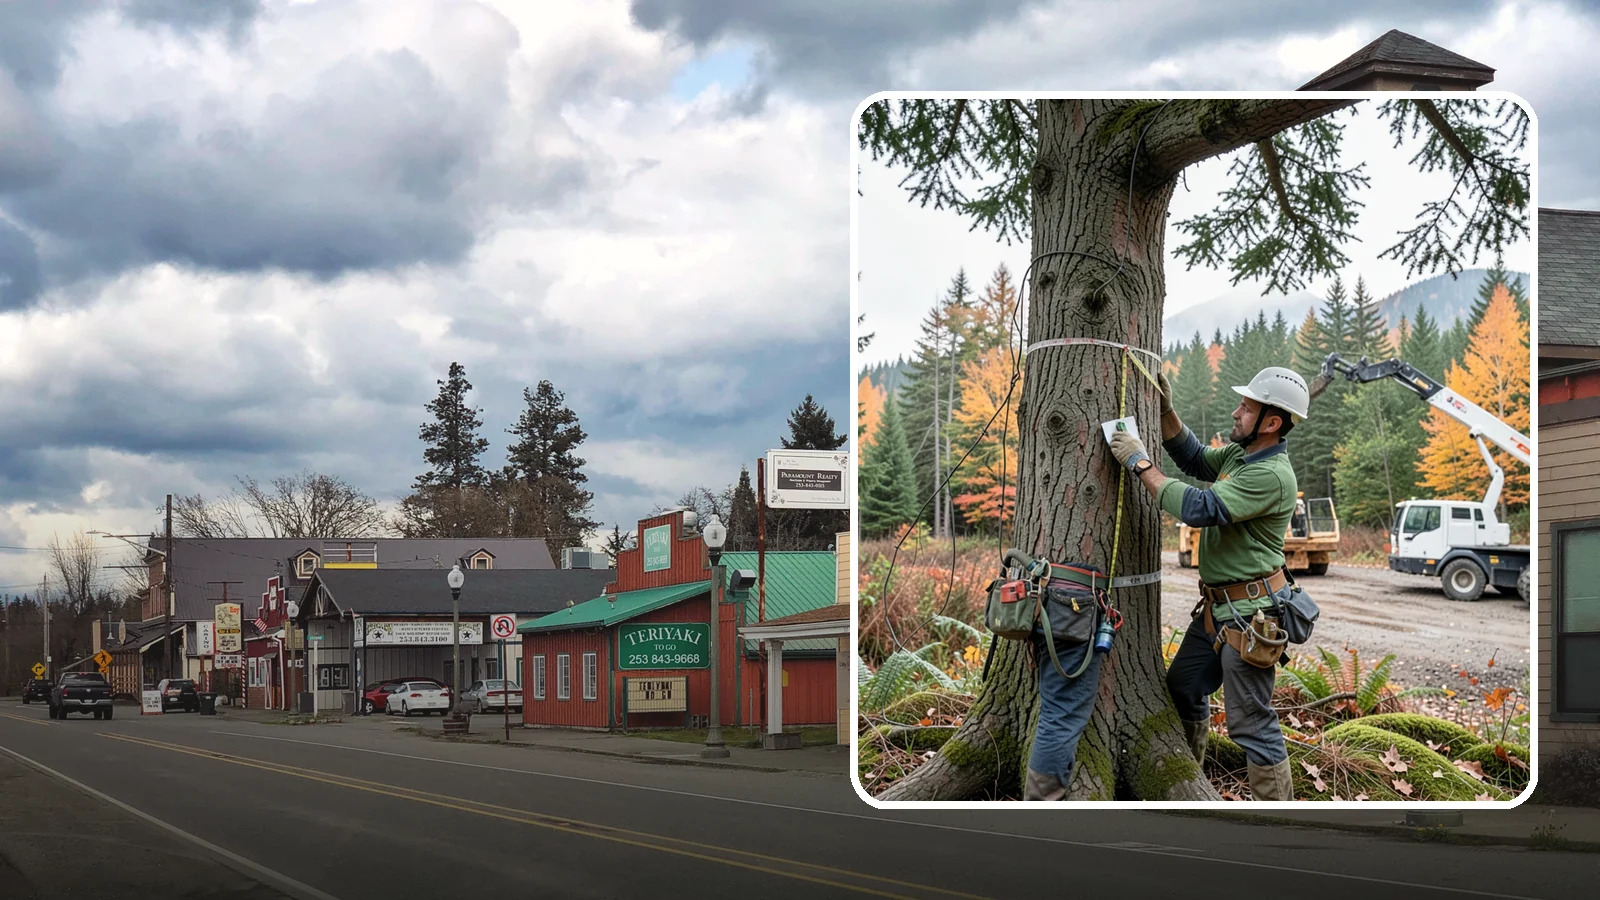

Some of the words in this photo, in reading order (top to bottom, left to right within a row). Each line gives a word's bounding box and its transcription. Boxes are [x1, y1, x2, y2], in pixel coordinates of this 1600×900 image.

[624, 627, 703, 646] TERIYAKI
[629, 654, 649, 664] 253
[651, 653, 700, 664] 843-9668
[639, 681, 673, 690] TERIYAKI
